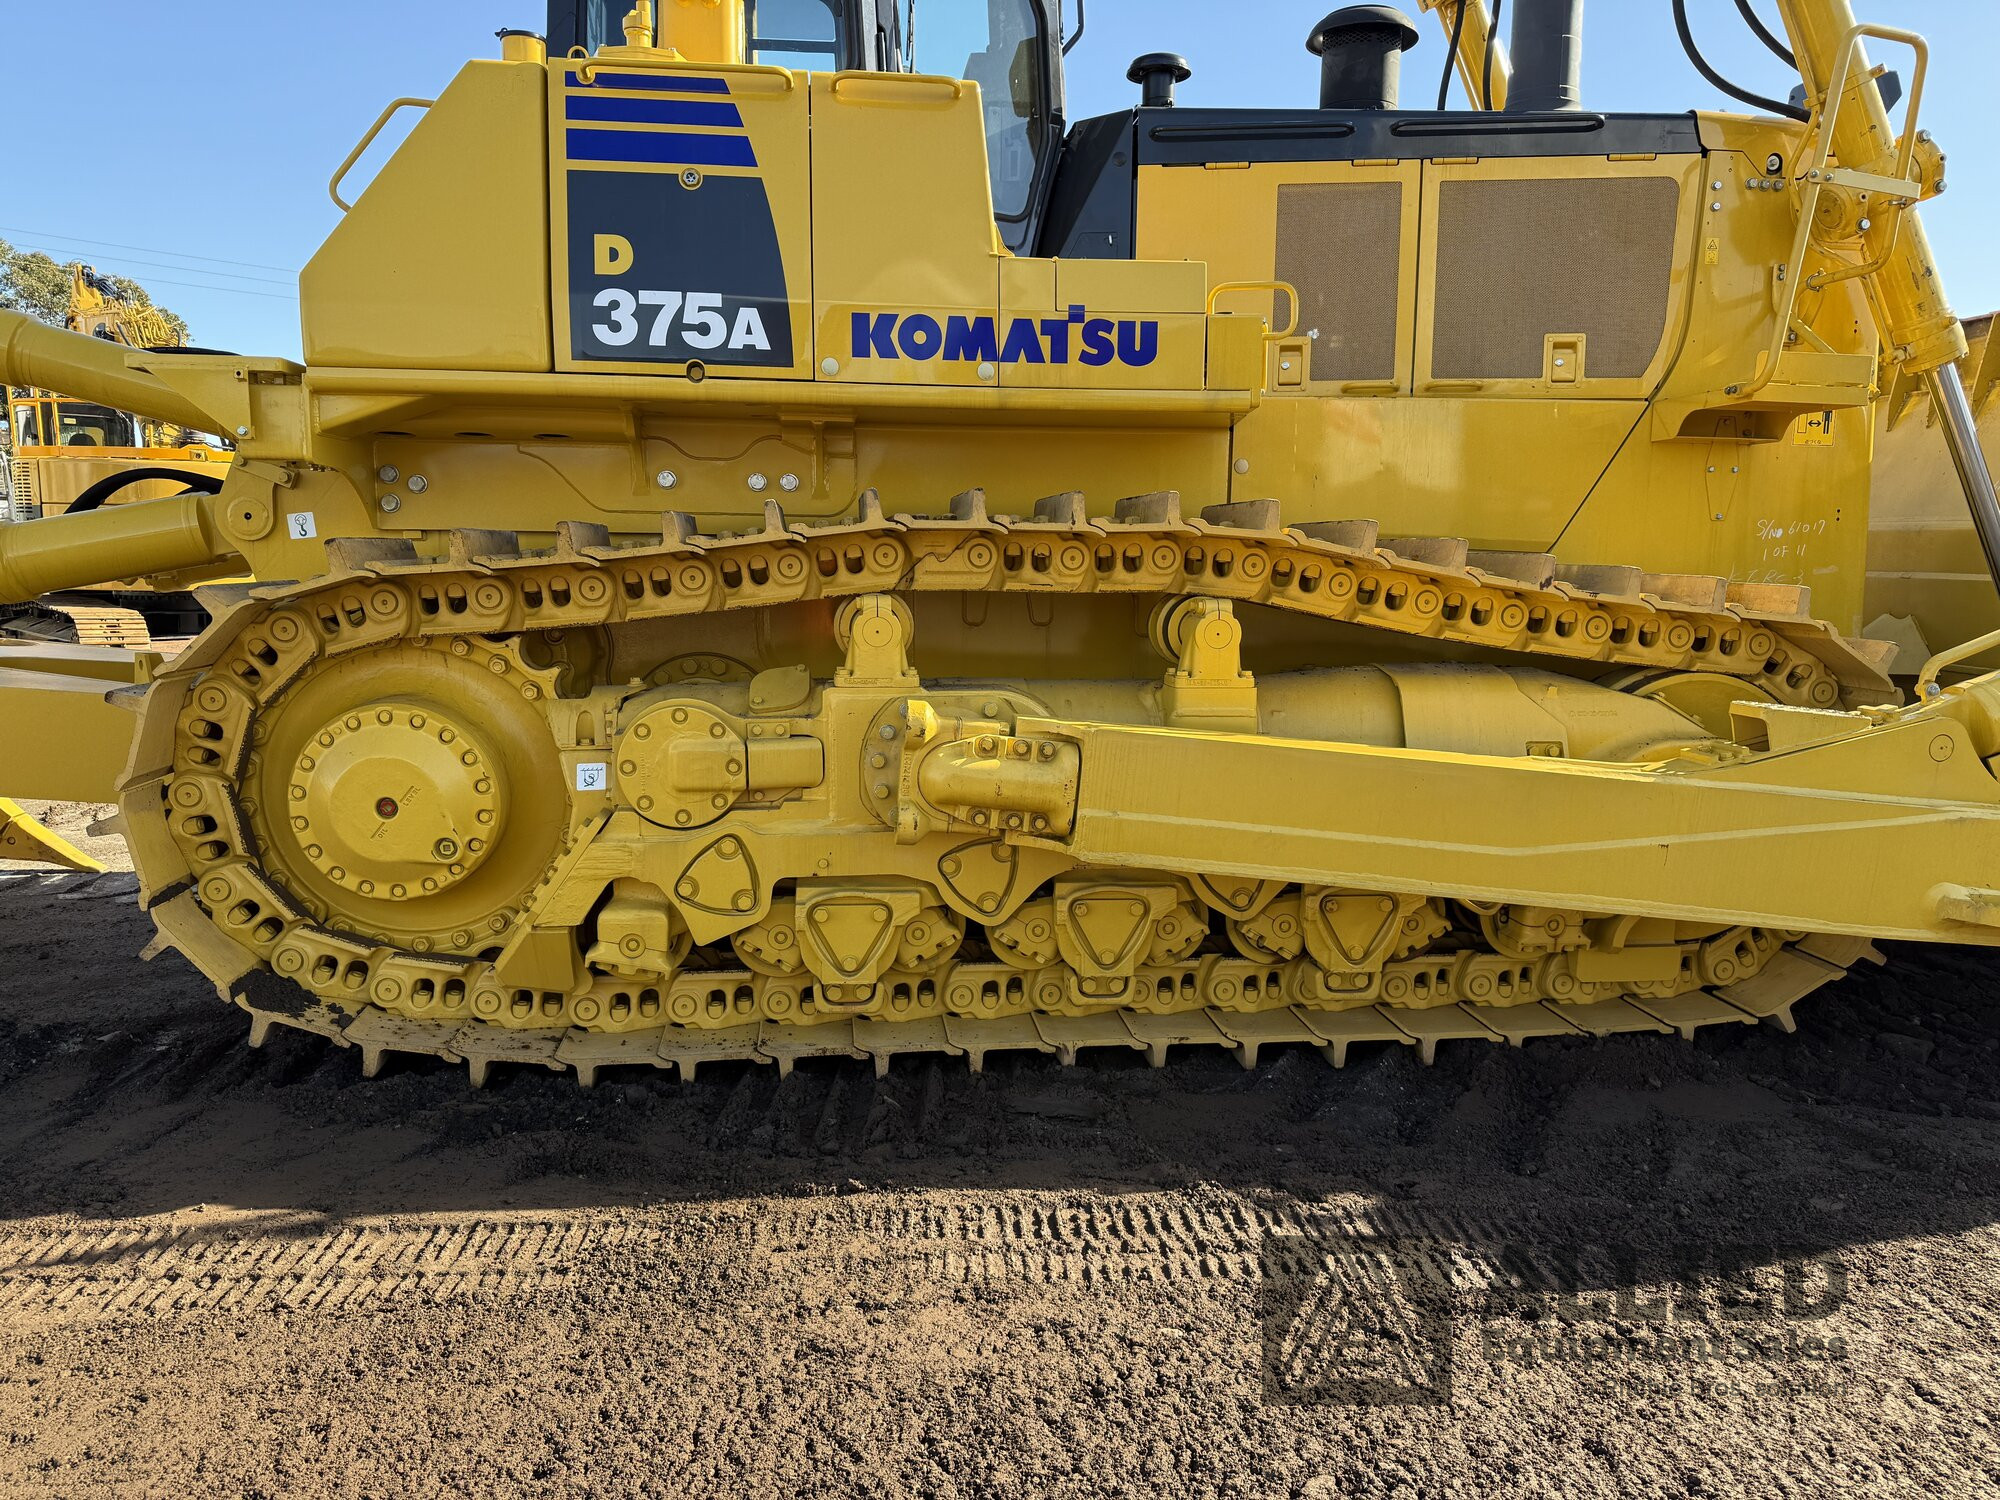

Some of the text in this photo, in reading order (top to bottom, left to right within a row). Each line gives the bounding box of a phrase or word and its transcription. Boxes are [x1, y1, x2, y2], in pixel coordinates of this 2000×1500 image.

[593, 233, 634, 276] D
[592, 287, 772, 350] 375A
[851, 304, 1159, 367] KOMATSU
[1773, 545, 1789, 557] OF
[377, 787, 421, 838] OIL LEVEL
